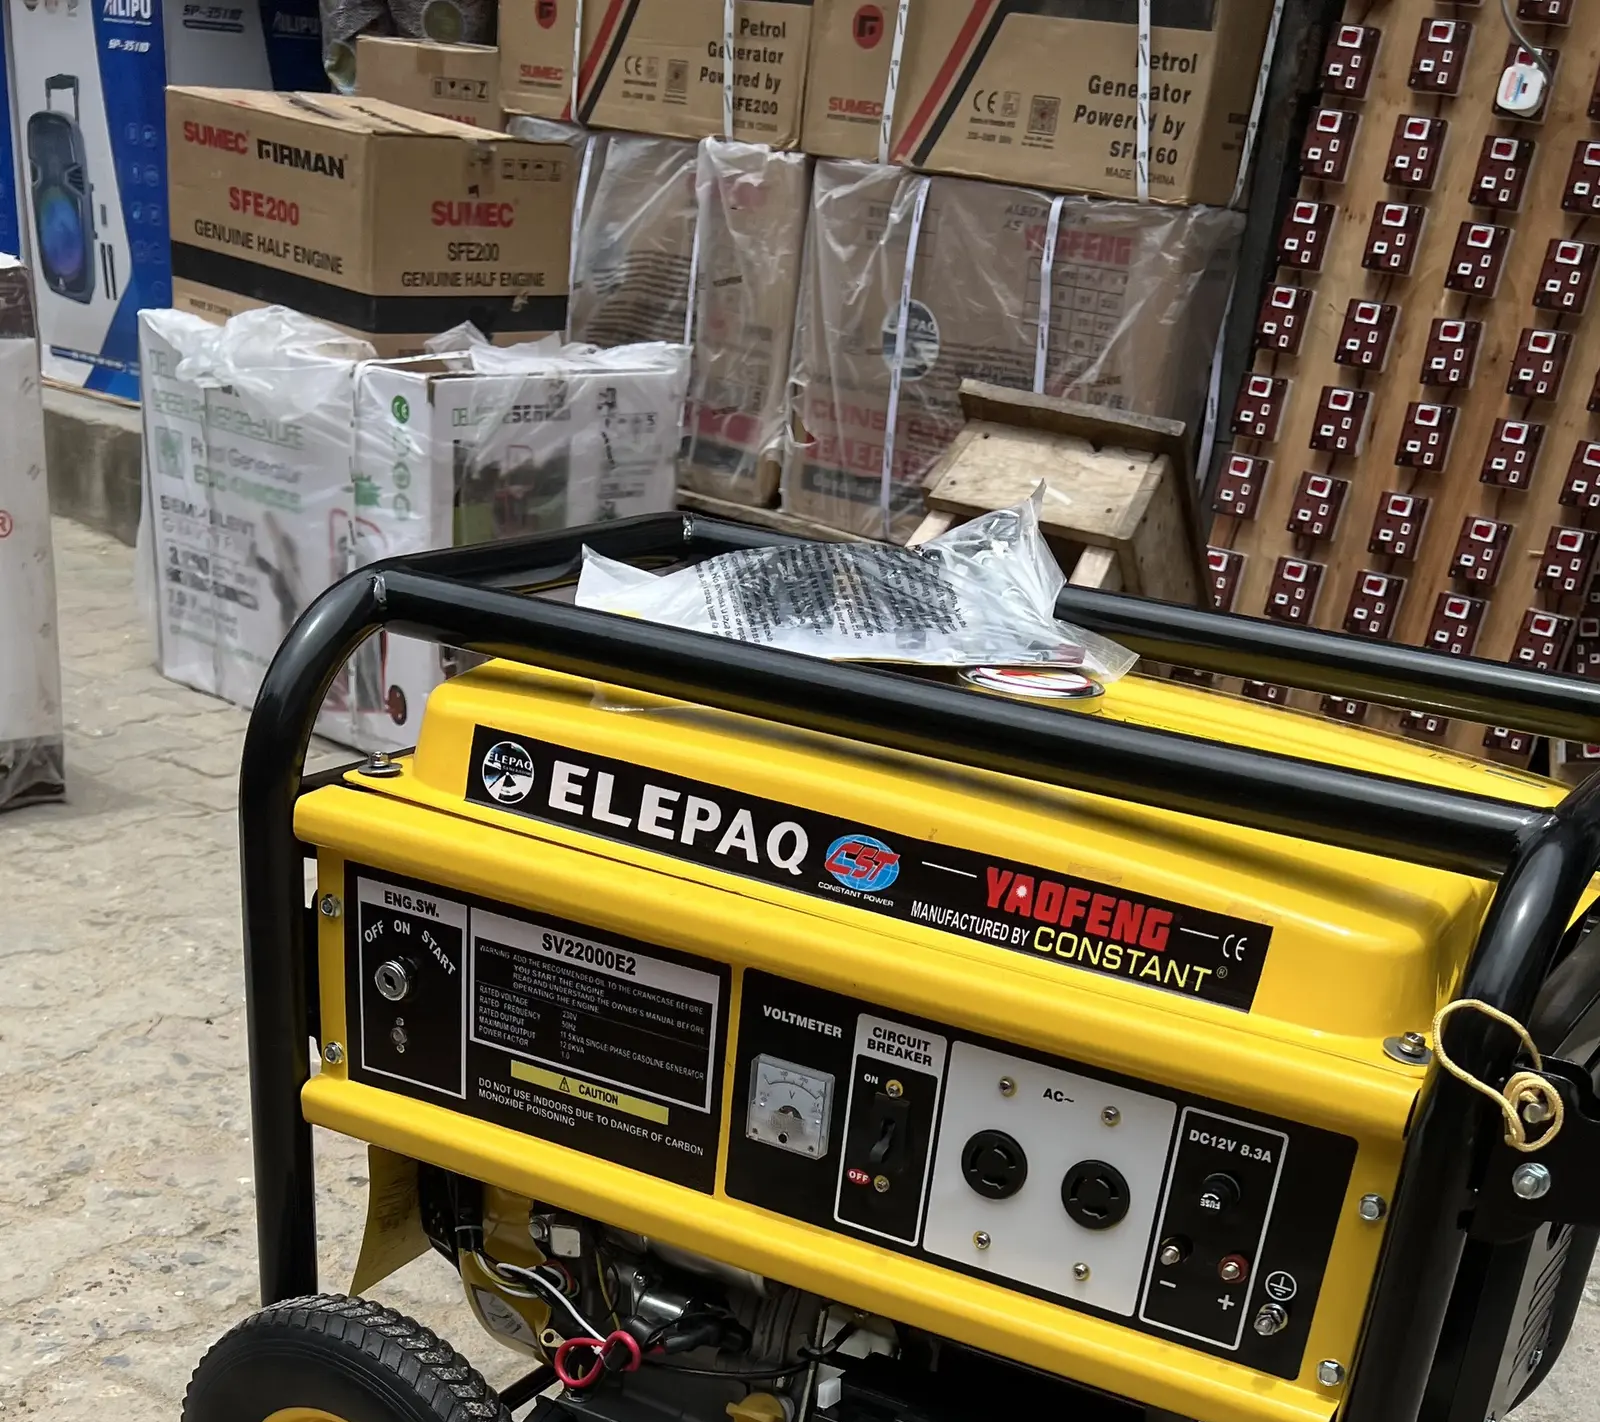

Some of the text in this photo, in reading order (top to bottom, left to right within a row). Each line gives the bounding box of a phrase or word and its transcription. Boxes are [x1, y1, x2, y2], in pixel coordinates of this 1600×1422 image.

[739, 18, 786, 39] Petrol
[1135, 49, 1198, 74] etrol
[700, 66, 782, 94] Powred by
[1088, 75, 1191, 104] Geneator
[733, 97, 778, 115] FE200
[829, 97, 883, 117] SUMEC
[1162, 114, 1186, 141] by
[184, 121, 345, 180] SUMEC FIRMAN
[1105, 167, 1132, 180] MADE
[229, 187, 300, 227] SFE200
[431, 201, 514, 228] SUMEC
[194, 219, 344, 275] GENUINE HALF ENGINE
[448, 243, 500, 262] SFE200
[402, 271, 546, 288] GENUINE HALF ENGINE
[487, 751, 532, 771] ELEPAQ
[548, 760, 809, 875] ELEPAQ
[824, 840, 901, 881] CST
[384, 890, 440, 918] ENG.SW.
[818, 880, 894, 908] CONSTANT POWER
[985, 866, 1174, 952] YAOFENG
[364, 920, 456, 976] OFF ON START
[541, 933, 637, 976] SV22000E2
[910, 900, 1212, 992] MANUFACTURED BY CONSTANT
[1223, 934, 1248, 962] CE
[513, 964, 605, 998] YOU START THE ENGINE
[528, 959, 541, 969] THE
[542, 962, 594, 984] RECOMMENDED
[595, 978, 606, 988] OIL
[608, 981, 617, 990] TO
[618, 984, 631, 995] THE
[632, 988, 675, 1007] CRANKCASE
[480, 985, 529, 1007] RATED VOLTAGE
[480, 995, 541, 1020] RATED FREQUENCY
[513, 982, 600, 1014] OPERATING THE ENGINE
[513, 972, 532, 984] READ
[533, 979, 548, 989] AND
[549, 984, 595, 1003] UNDERSTAND
[597, 998, 610, 1008] THE
[646, 1011, 675, 1027] MANUAL
[677, 1020, 705, 1036] BEFORE
[479, 1006, 525, 1026] RATED OUTPUT
[479, 1016, 536, 1040] MAXIMUM OUTPUT
[763, 1004, 843, 1038] VOLTMETER
[479, 1024, 501, 1038] POWER
[872, 1026, 931, 1052] CIRCUIT
[585, 1040, 609, 1053] SINGLE
[609, 1045, 631, 1060] PHASE
[632, 1051, 665, 1069] GASOLINE
[665, 1062, 704, 1081] GENERATOR
[866, 1038, 933, 1067] BREAKER
[864, 1073, 879, 1085] ON
[478, 1088, 576, 1128] MONOXIDE POISONING
[578, 1084, 619, 1106] CAUTION
[789, 1090, 796, 1100] V
[478, 1077, 704, 1157] DO NOT USE INDOORS DUE TO DANGER OF CARBON
[1189, 1129, 1272, 1164] DC12V 8.3A
[848, 1170, 870, 1183] OFF
[1200, 1198, 1221, 1211] FUSE
